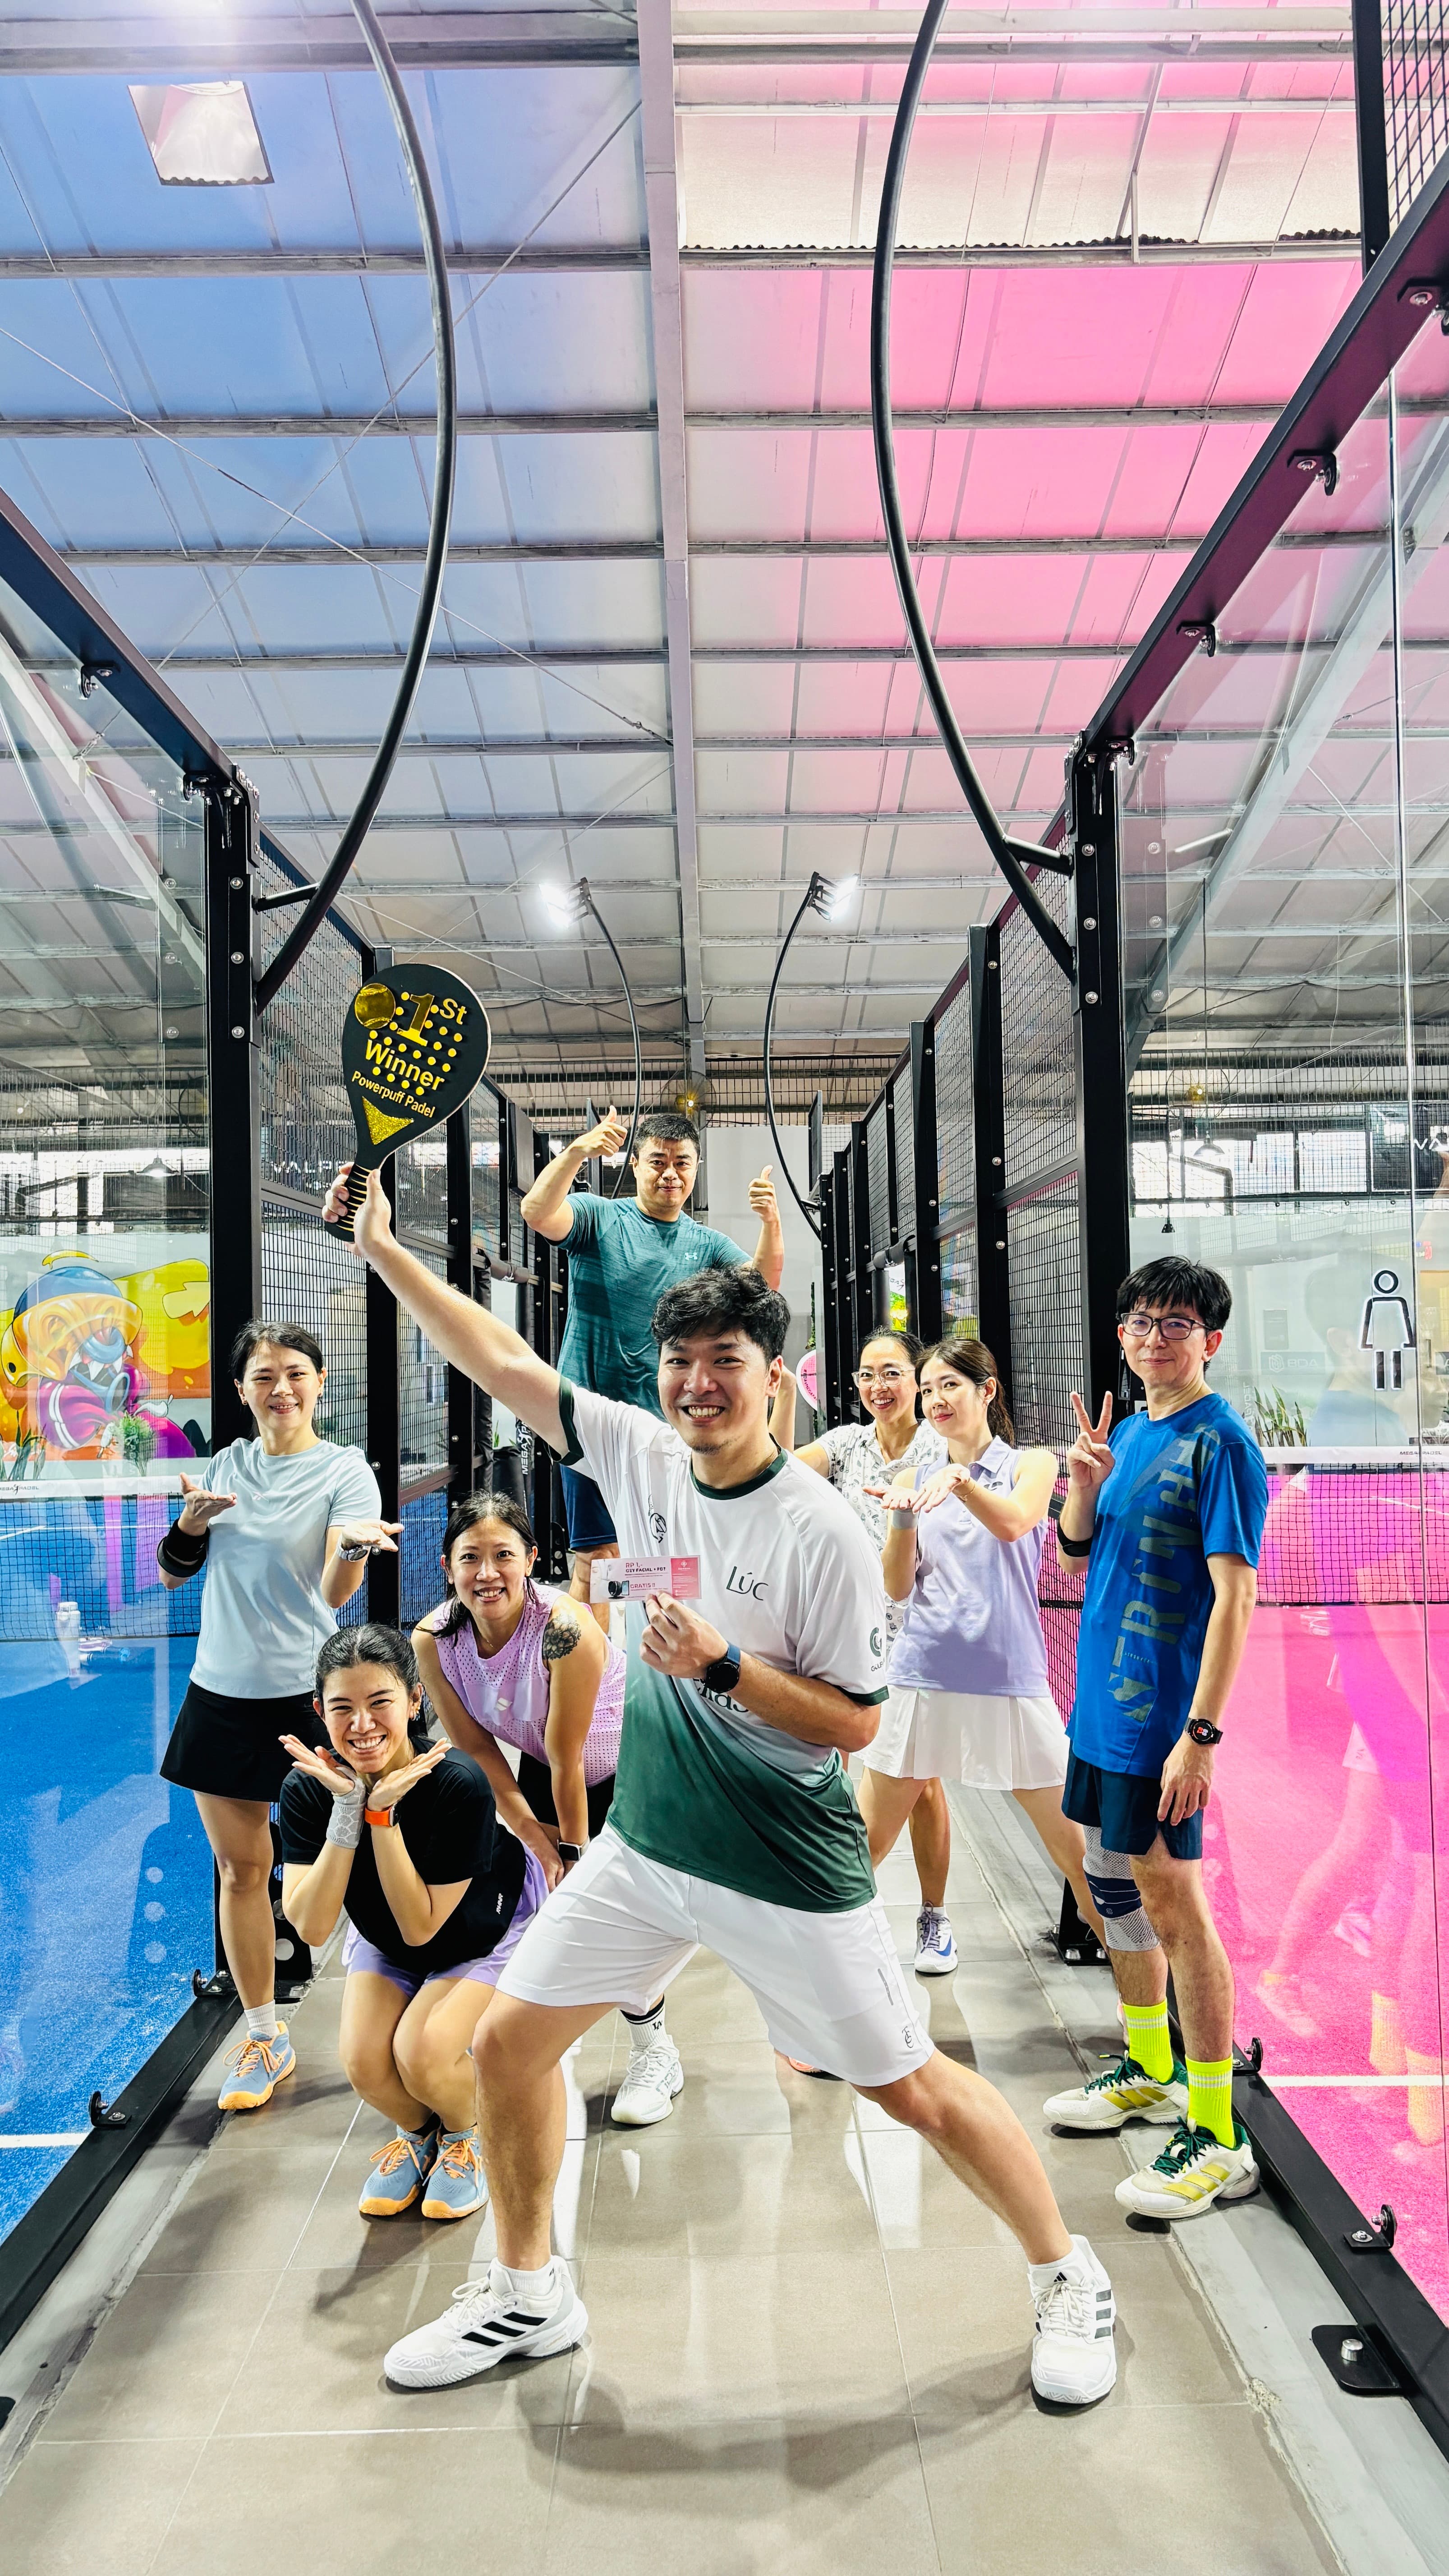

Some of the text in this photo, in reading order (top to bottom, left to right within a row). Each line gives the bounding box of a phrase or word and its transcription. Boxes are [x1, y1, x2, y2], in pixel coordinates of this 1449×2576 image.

[365, 1039, 445, 1090] Winner
[352, 1071, 436, 1118] Powerpuff Padel
[1288, 1359, 1317, 1367] BDA
